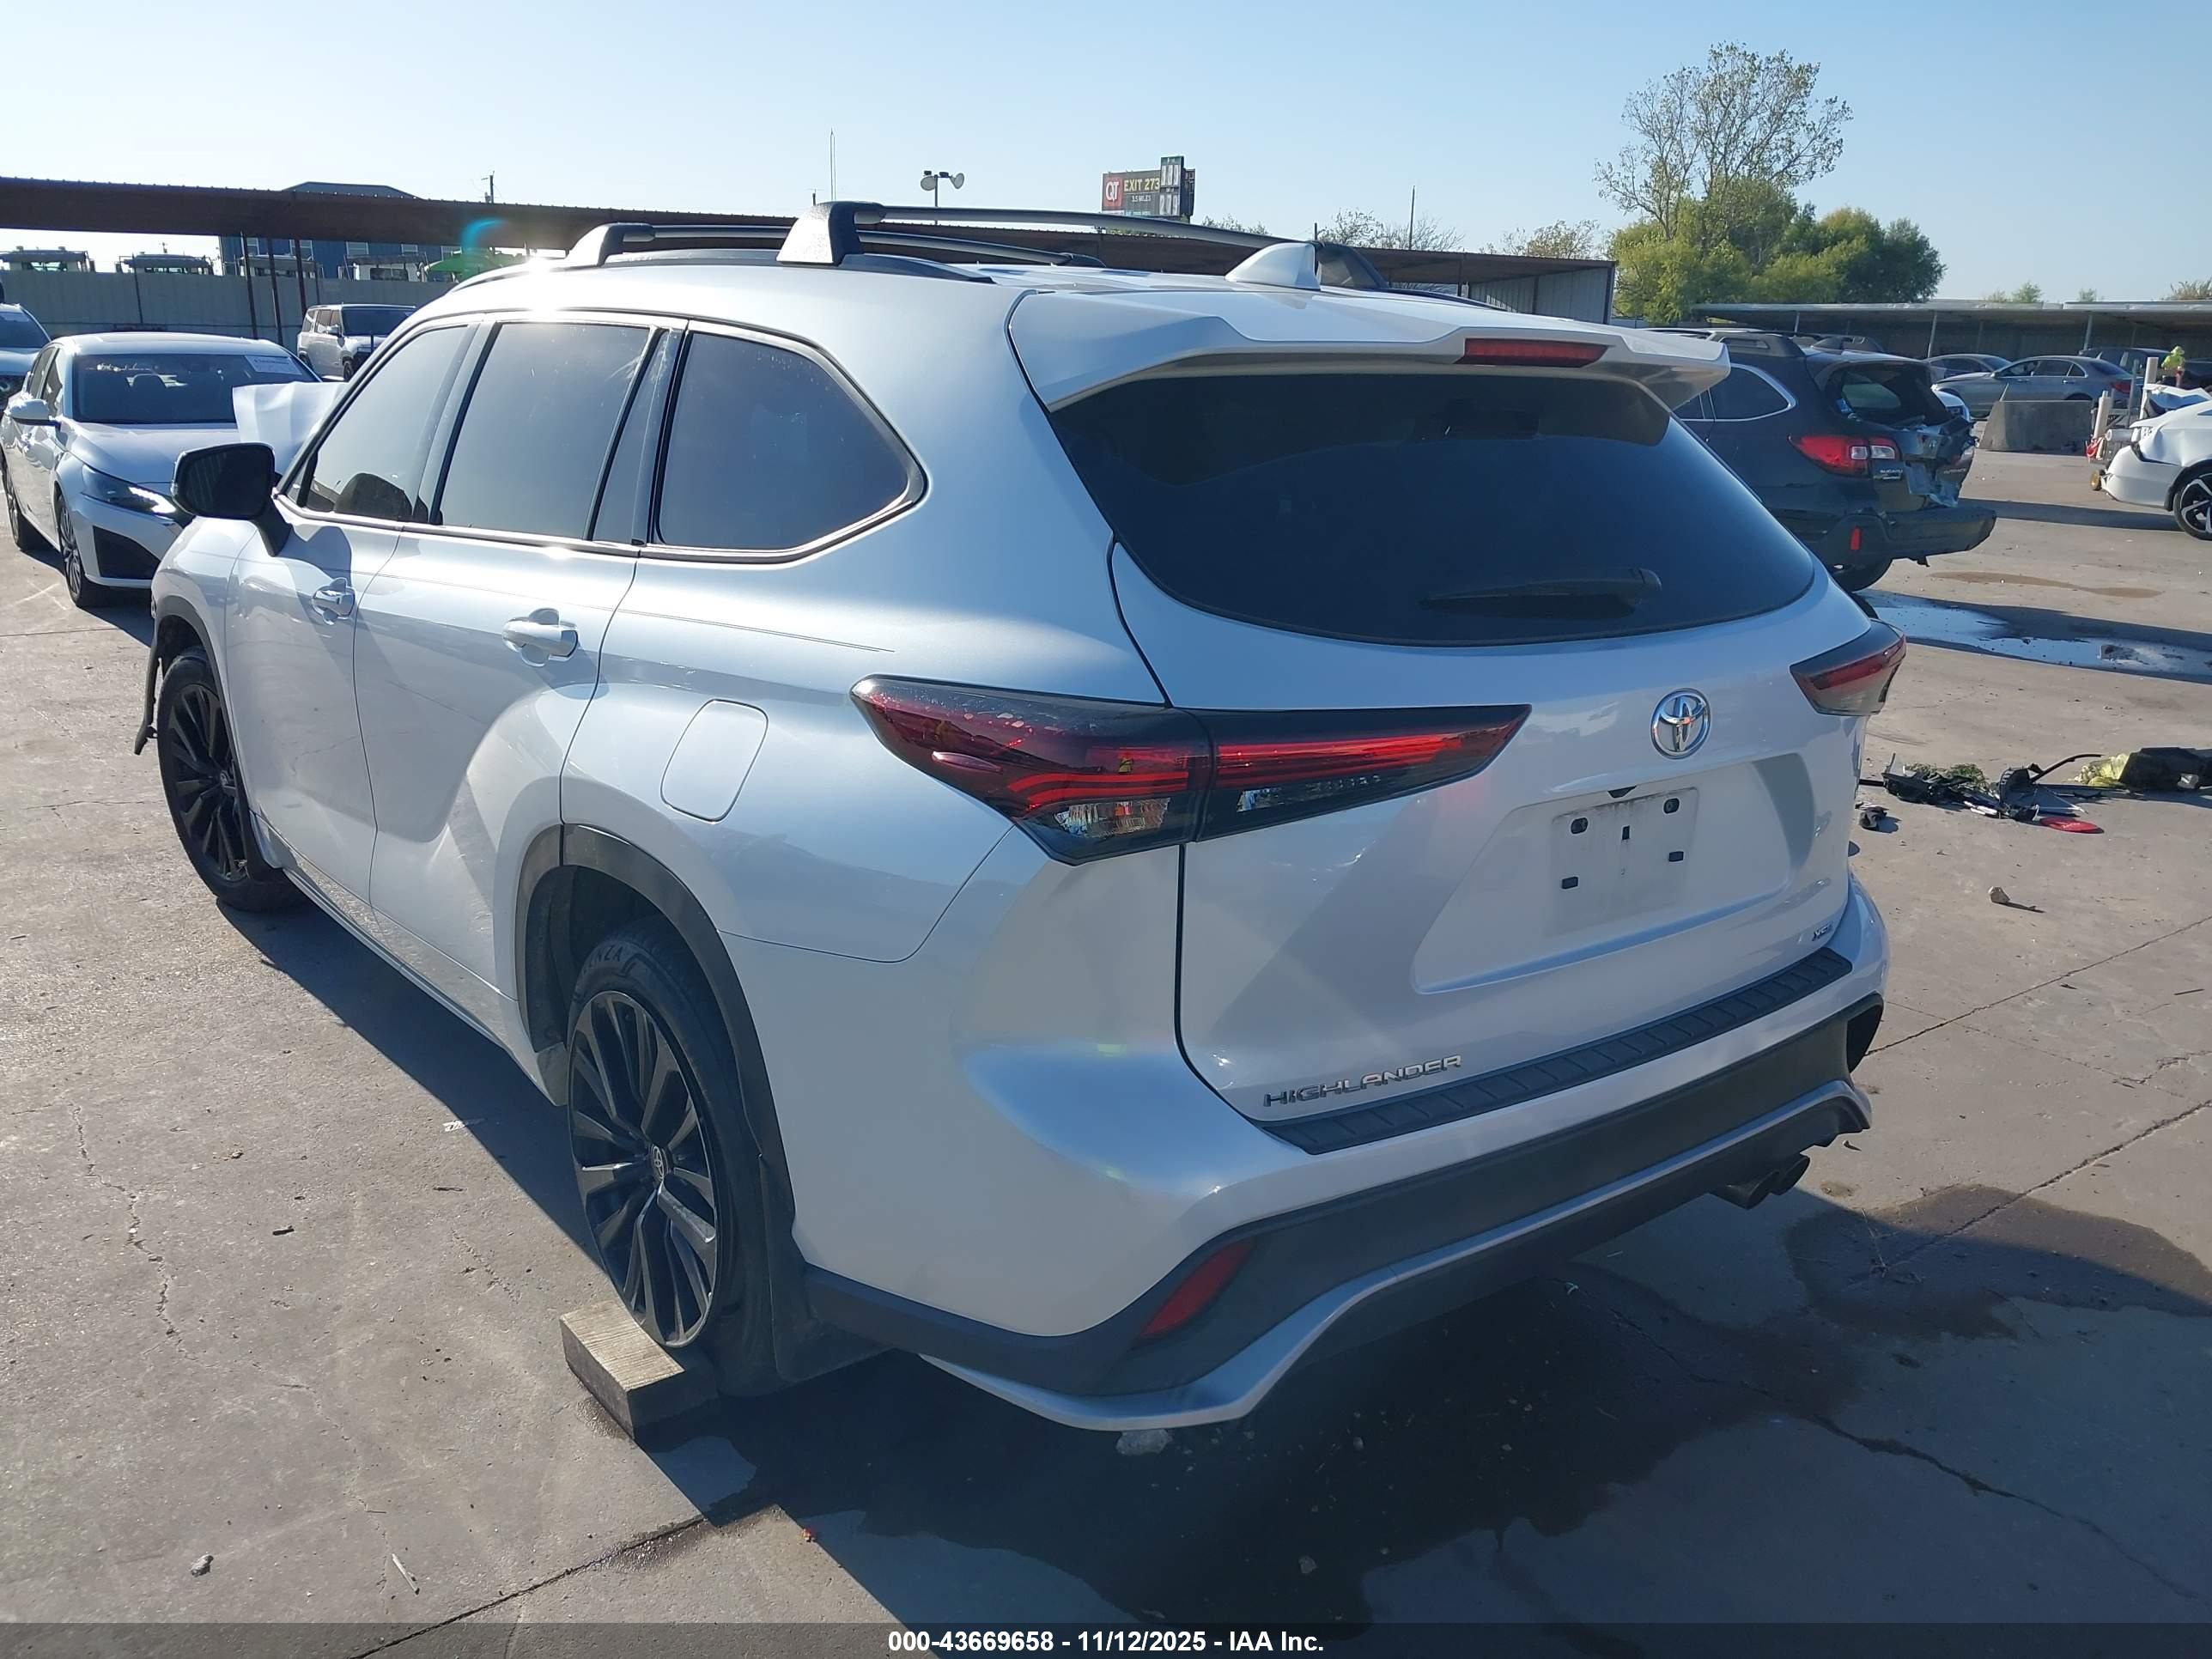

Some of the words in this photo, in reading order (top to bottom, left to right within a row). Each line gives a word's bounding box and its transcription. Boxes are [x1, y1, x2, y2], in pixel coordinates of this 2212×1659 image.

[1106, 181, 1120, 202] QT
[1124, 179, 1143, 191] EXIT
[1144, 177, 1160, 191] 273
[1263, 1054, 1462, 1108] HIGHLANDER
